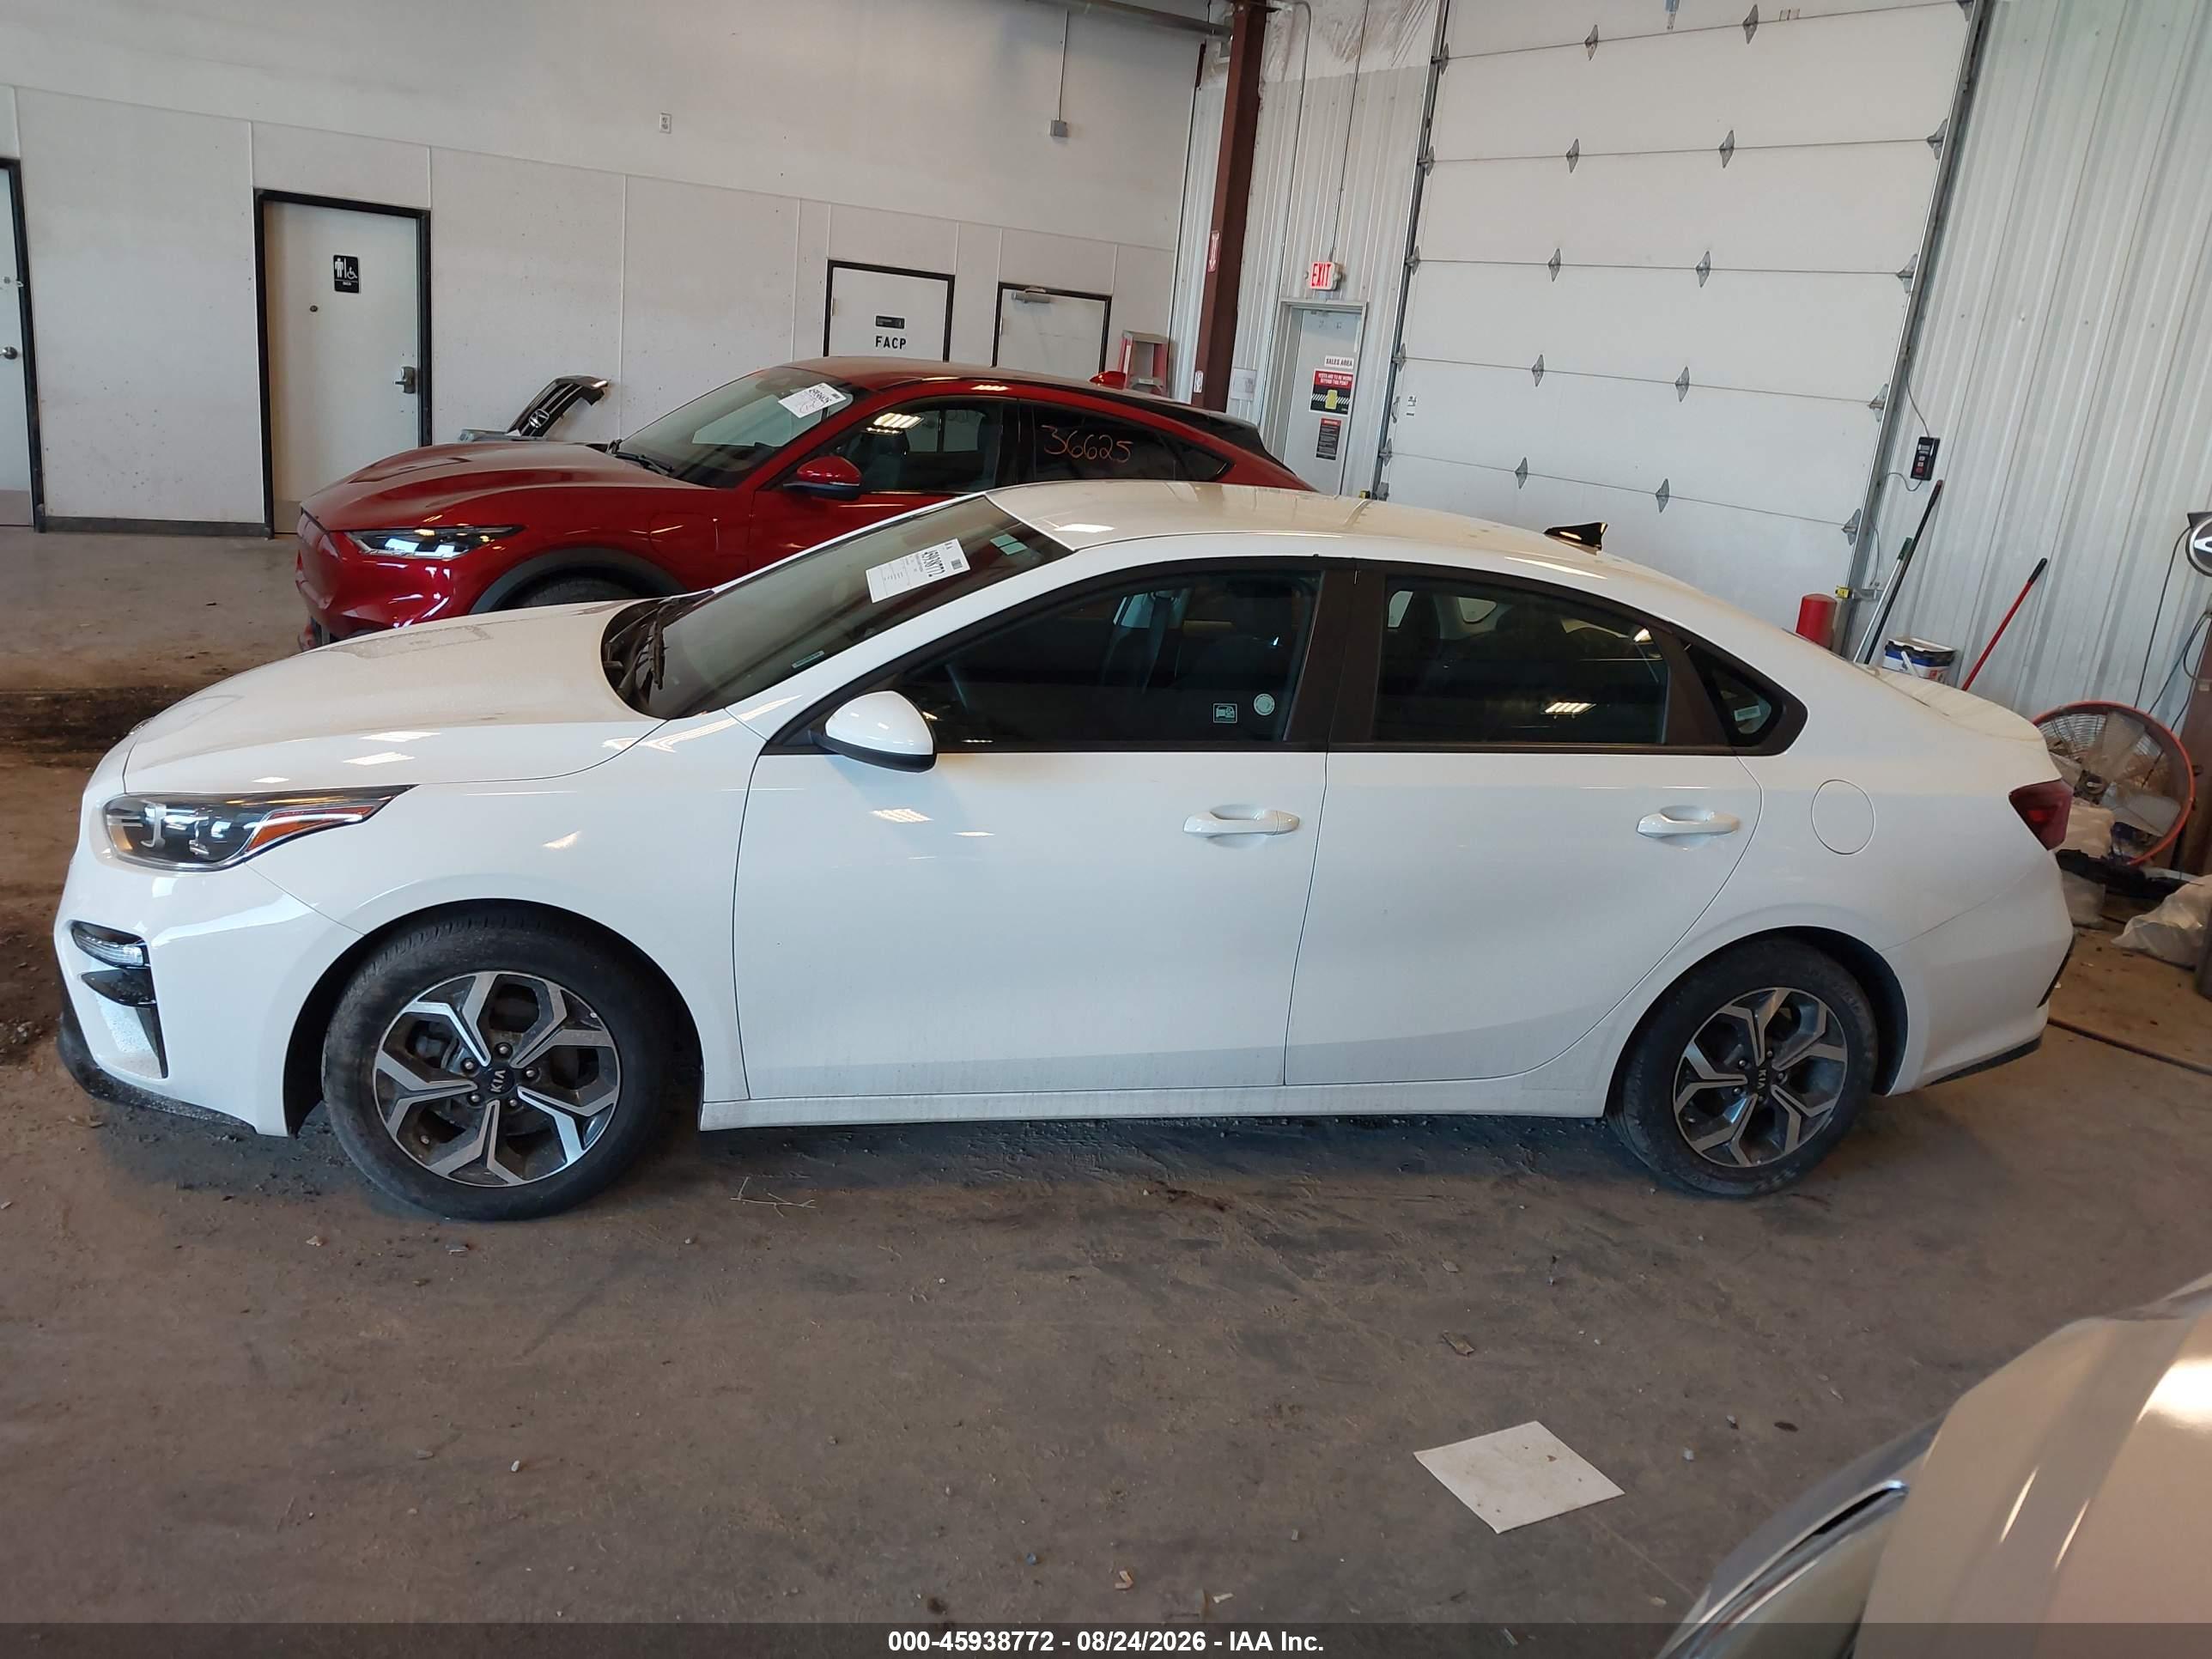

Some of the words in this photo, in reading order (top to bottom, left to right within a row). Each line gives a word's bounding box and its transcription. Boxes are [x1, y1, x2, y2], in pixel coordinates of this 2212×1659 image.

[1311, 263, 1332, 287] EXIT
[875, 335, 907, 349] FACP
[1041, 424, 1133, 464] 36625
[490, 1070, 506, 1093] KIA
[1757, 1069, 1767, 1090] KIA
